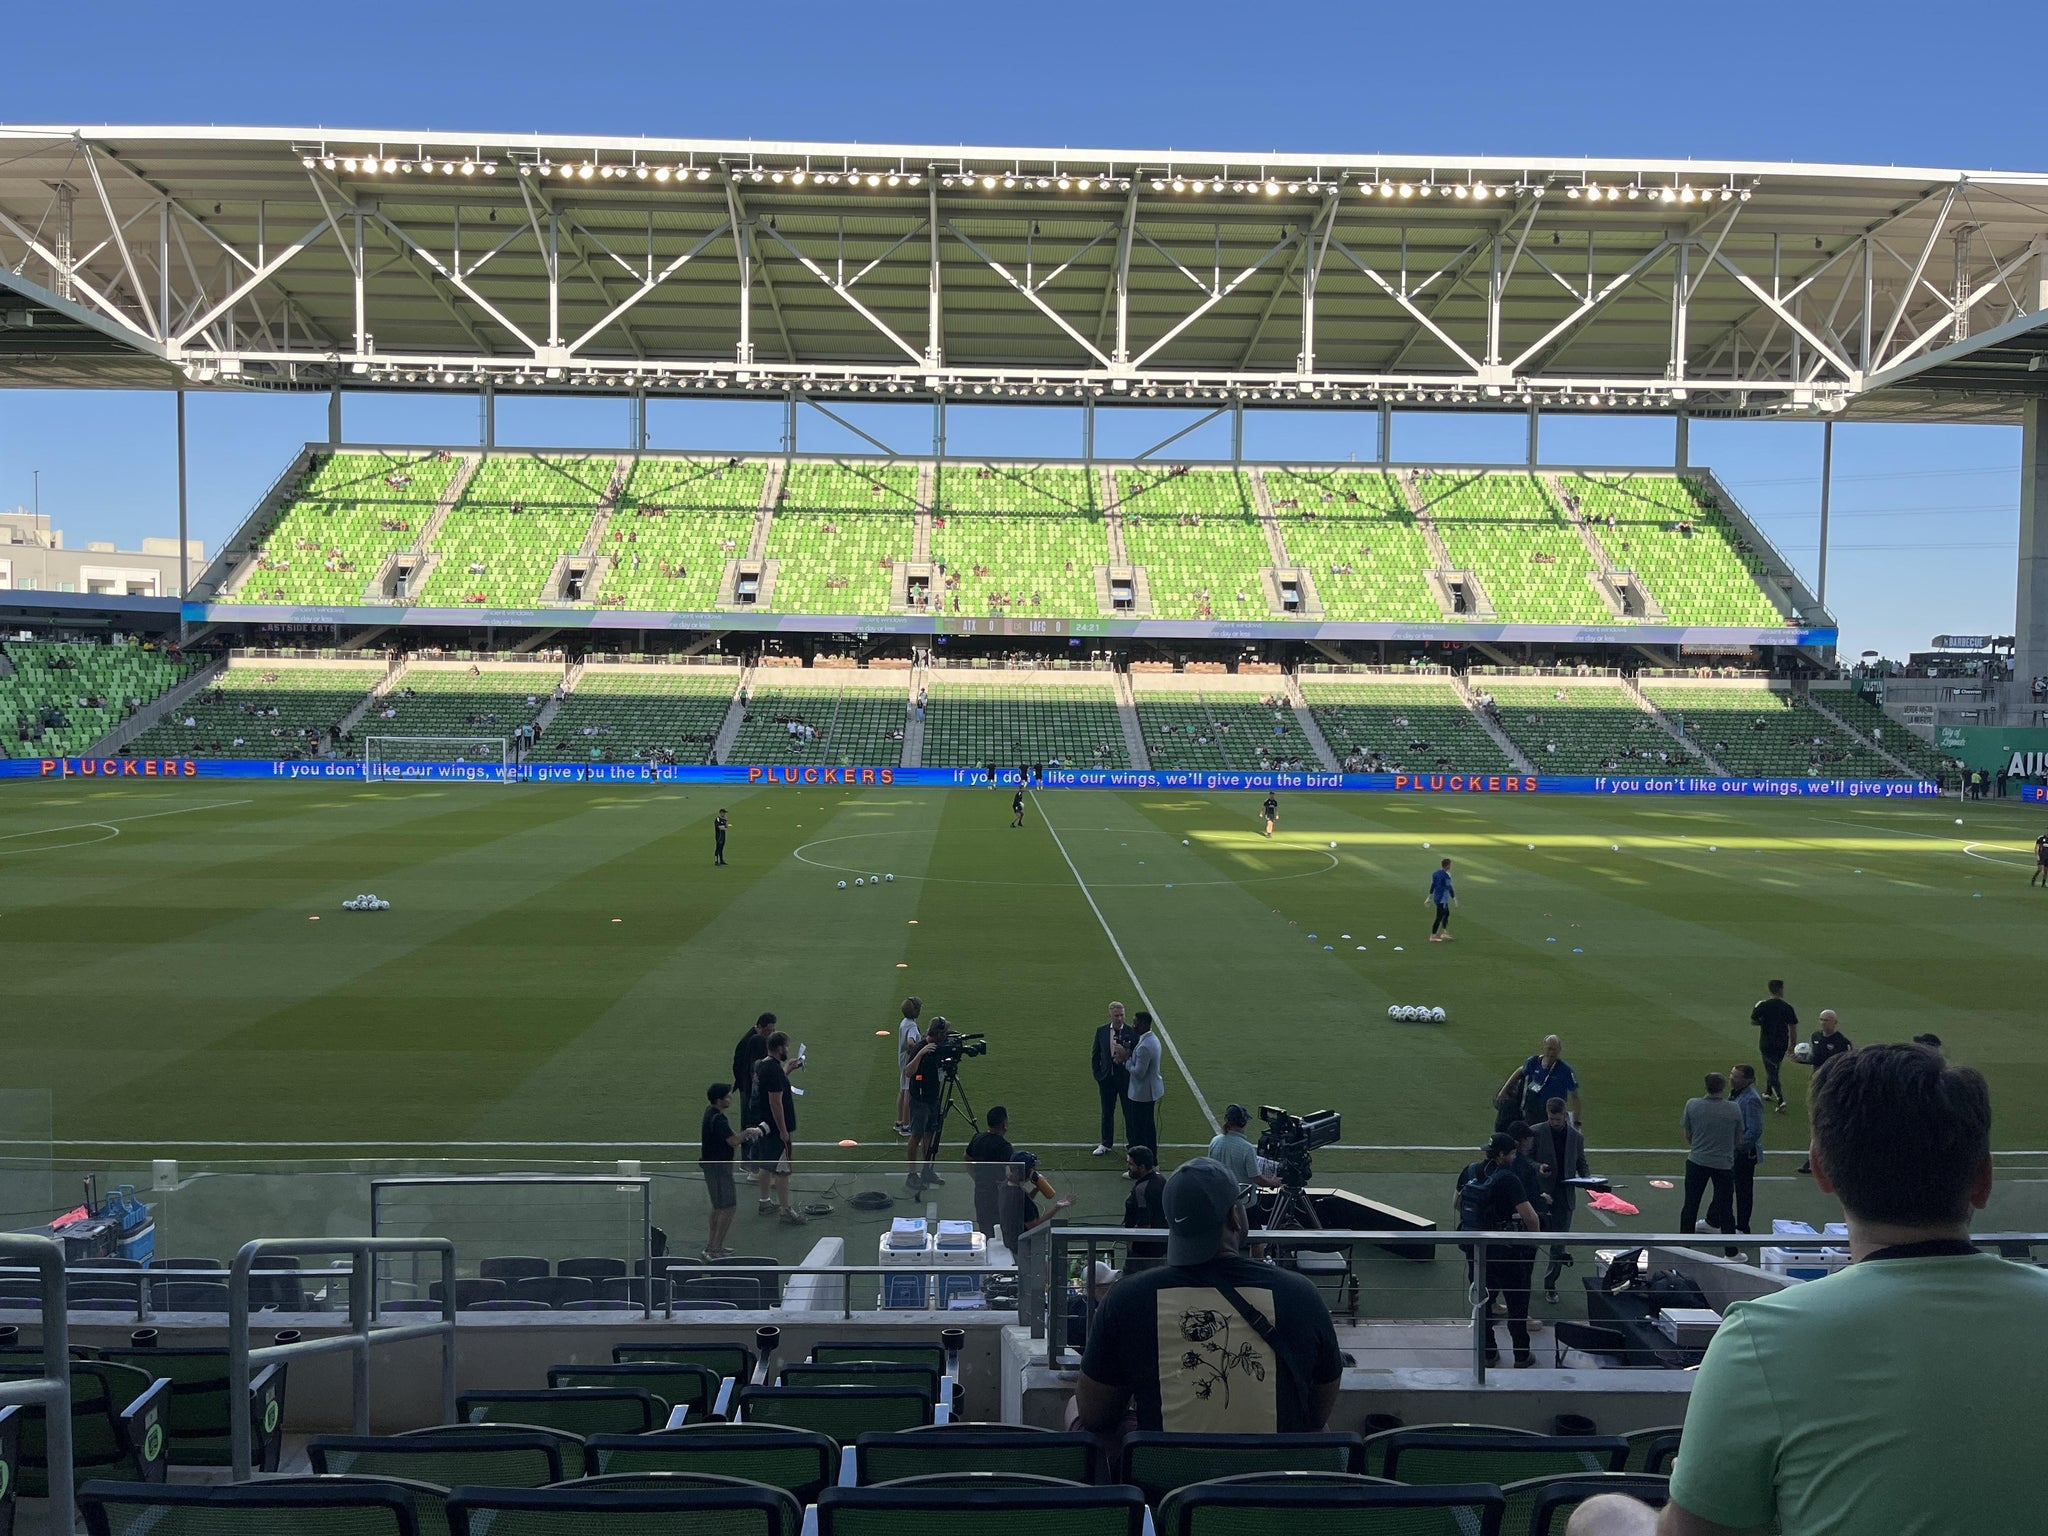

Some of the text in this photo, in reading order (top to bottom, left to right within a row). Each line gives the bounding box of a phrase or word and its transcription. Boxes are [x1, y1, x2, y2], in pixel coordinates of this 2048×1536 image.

[963, 620, 994, 631] ATX 0
[1030, 621, 1046, 632] LAFC
[1056, 621, 1061, 632] 0
[1076, 624, 1099, 632] 24:21
[1949, 637, 1983, 647] BARBECUE
[1863, 681, 1883, 692] AUSTIN
[1876, 693, 1882, 704] FC
[40, 760, 197, 776] PLUCKERS
[273, 762, 678, 780] If you don't like our wings, we'll give you the brd!
[748, 768, 893, 784] PLUCKERS
[954, 770, 963, 782] If
[1048, 771, 1074, 784] like
[1080, 774, 1106, 784] our
[1111, 772, 1160, 787] wings,
[1166, 773, 1202, 785] we'll
[1208, 774, 1239, 788] give
[1245, 776, 1271, 788] you
[1277, 774, 1302, 786] the
[1307, 774, 1343, 787] bird!
[1395, 776, 1537, 792] PLUCKERS
[1596, 778, 1938, 797] If you don't like our wings, we'll give you the
